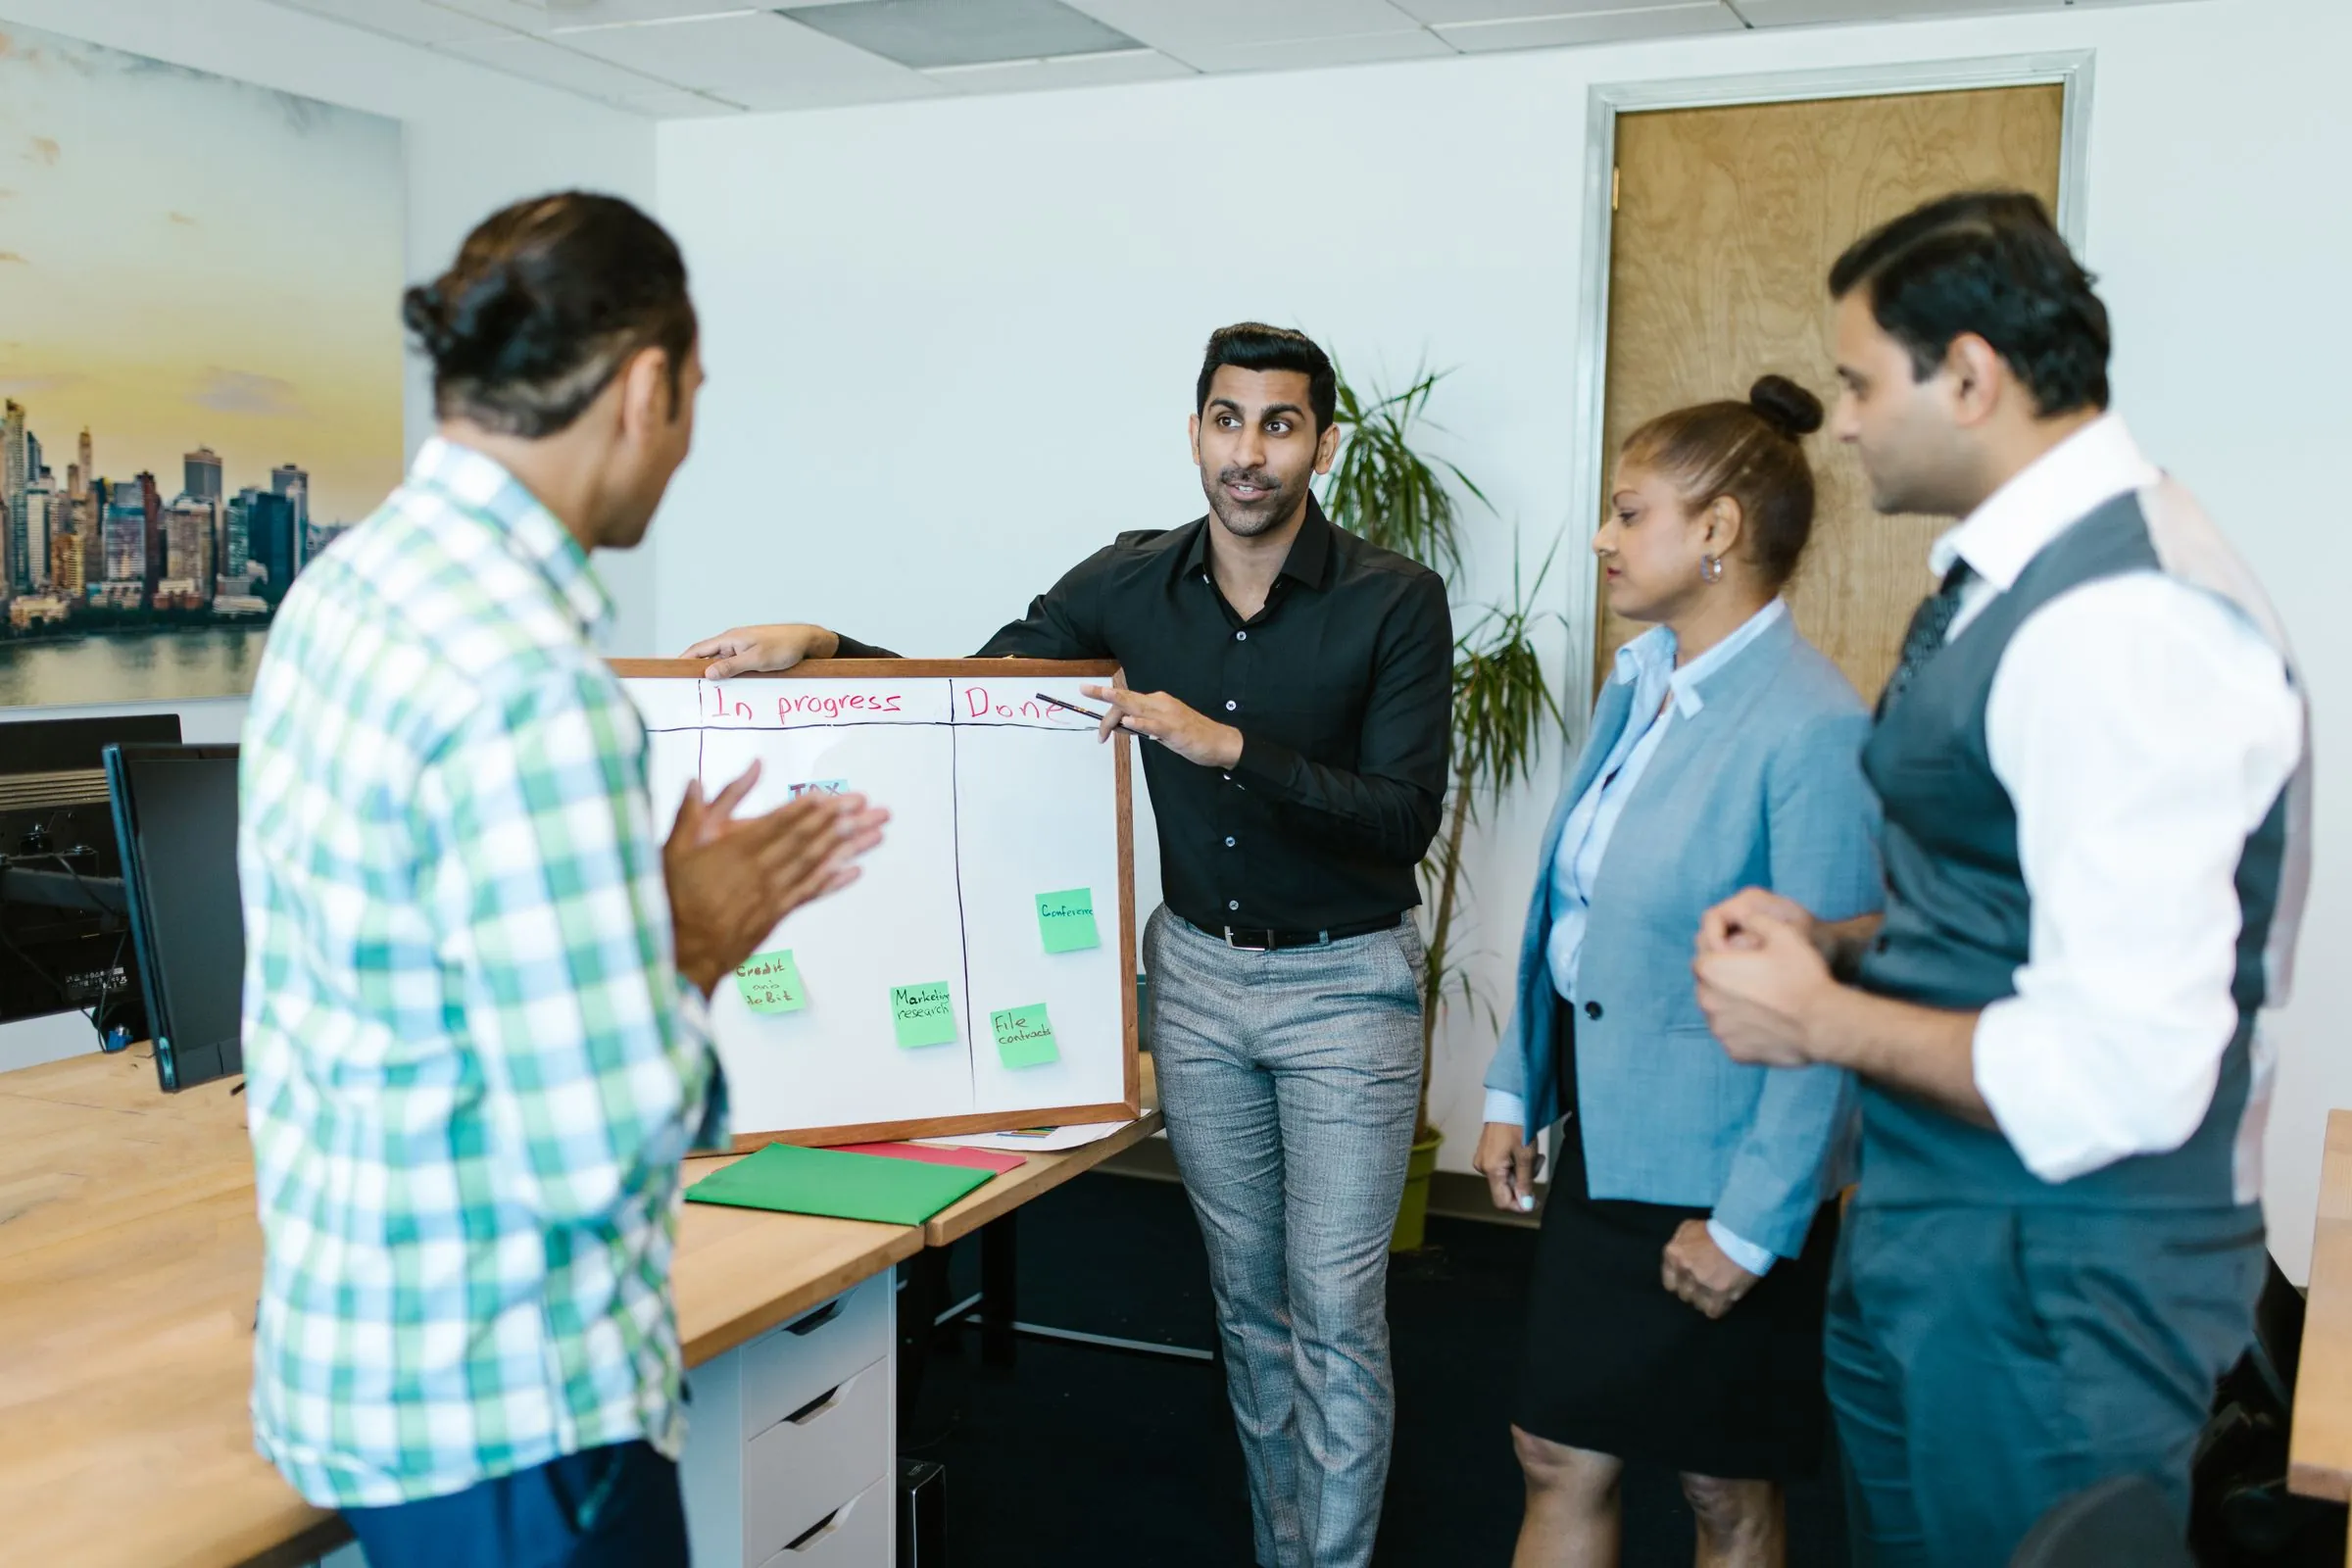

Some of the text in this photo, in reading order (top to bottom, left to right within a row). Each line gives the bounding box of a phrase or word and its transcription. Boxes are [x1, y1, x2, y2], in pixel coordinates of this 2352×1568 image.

[711, 685, 902, 725] In progress
[965, 686, 1072, 725] Done
[736, 957, 785, 978] Credit
[897, 1003, 950, 1020] research
[995, 1011, 1030, 1034] File
[998, 1023, 1052, 1045] contracts
